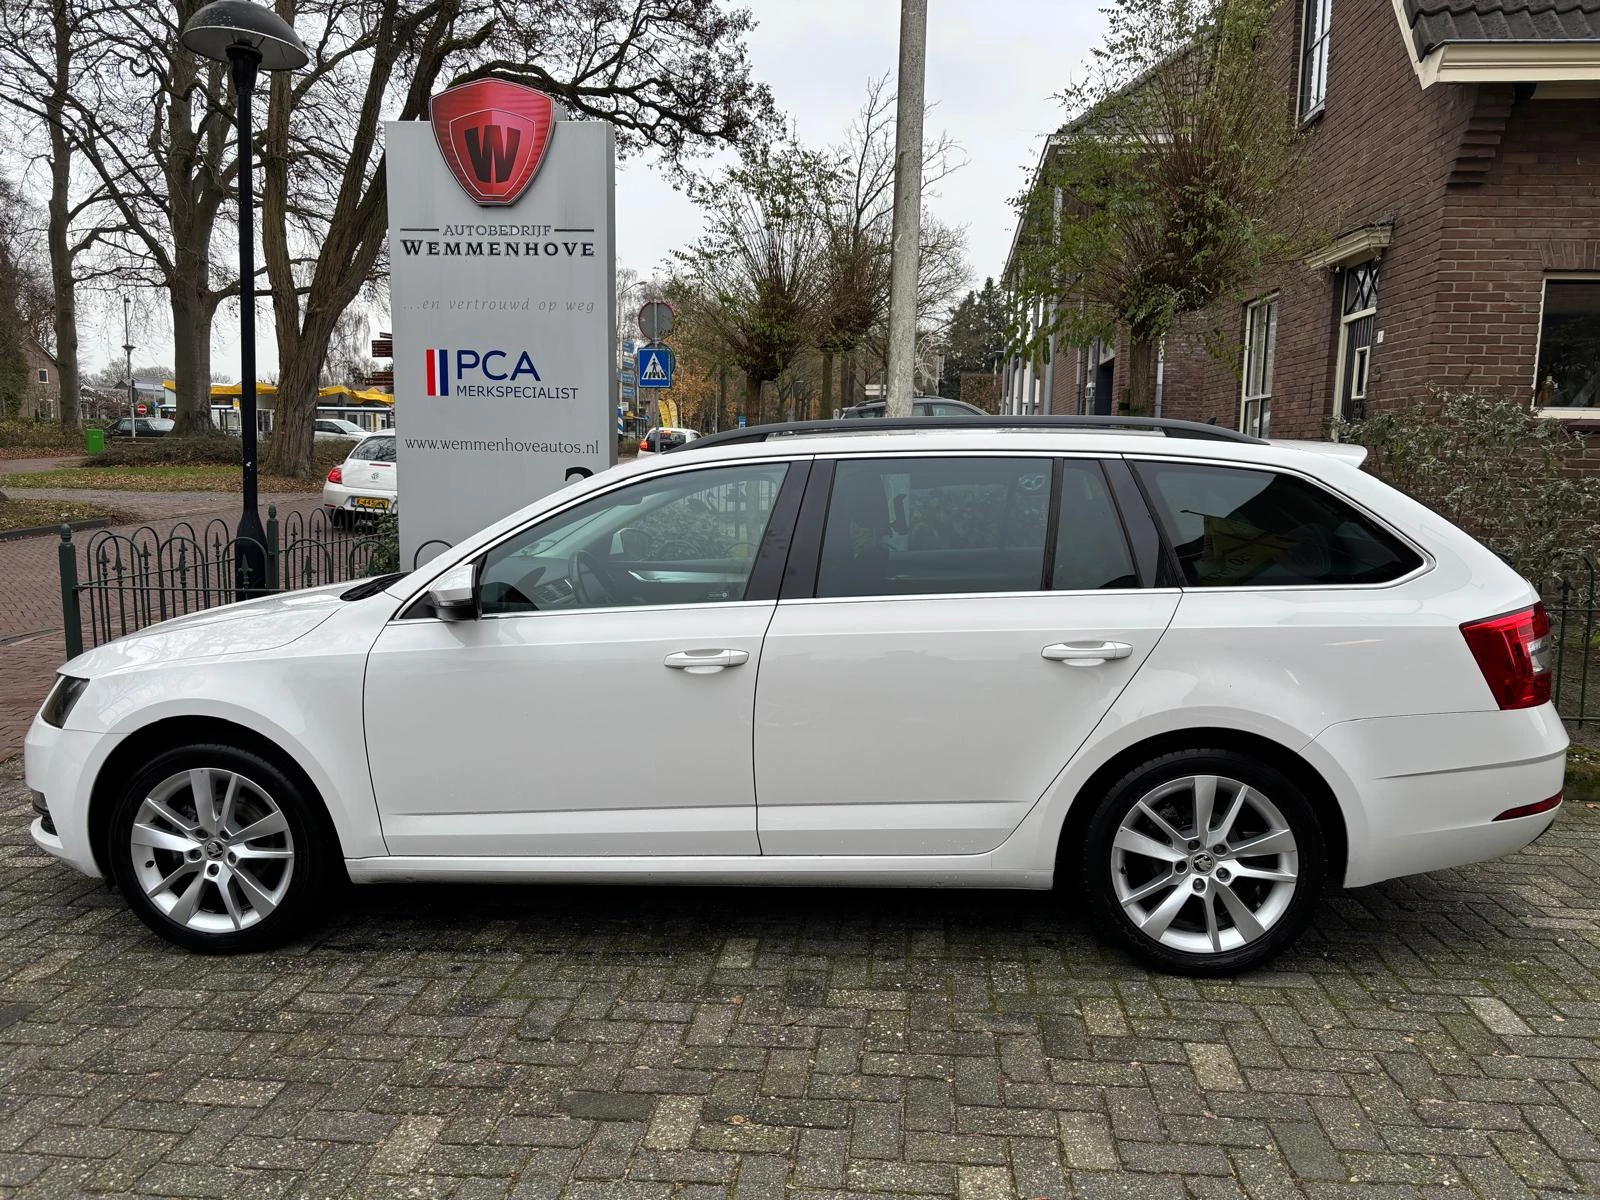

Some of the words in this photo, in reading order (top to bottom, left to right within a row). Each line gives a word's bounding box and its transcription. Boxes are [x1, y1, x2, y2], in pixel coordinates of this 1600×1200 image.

[464, 125, 521, 184] W
[443, 225, 552, 236] AUTOBEDRIJF
[400, 239, 595, 257] WEMMENHOVE
[449, 298, 530, 311] vertrouwd
[538, 301, 557, 313] op
[566, 302, 595, 314] weg
[456, 350, 541, 382] PCA
[456, 385, 579, 400] MERKSPECIALIST
[405, 437, 599, 454] www.wemmenhoveautos.nl
